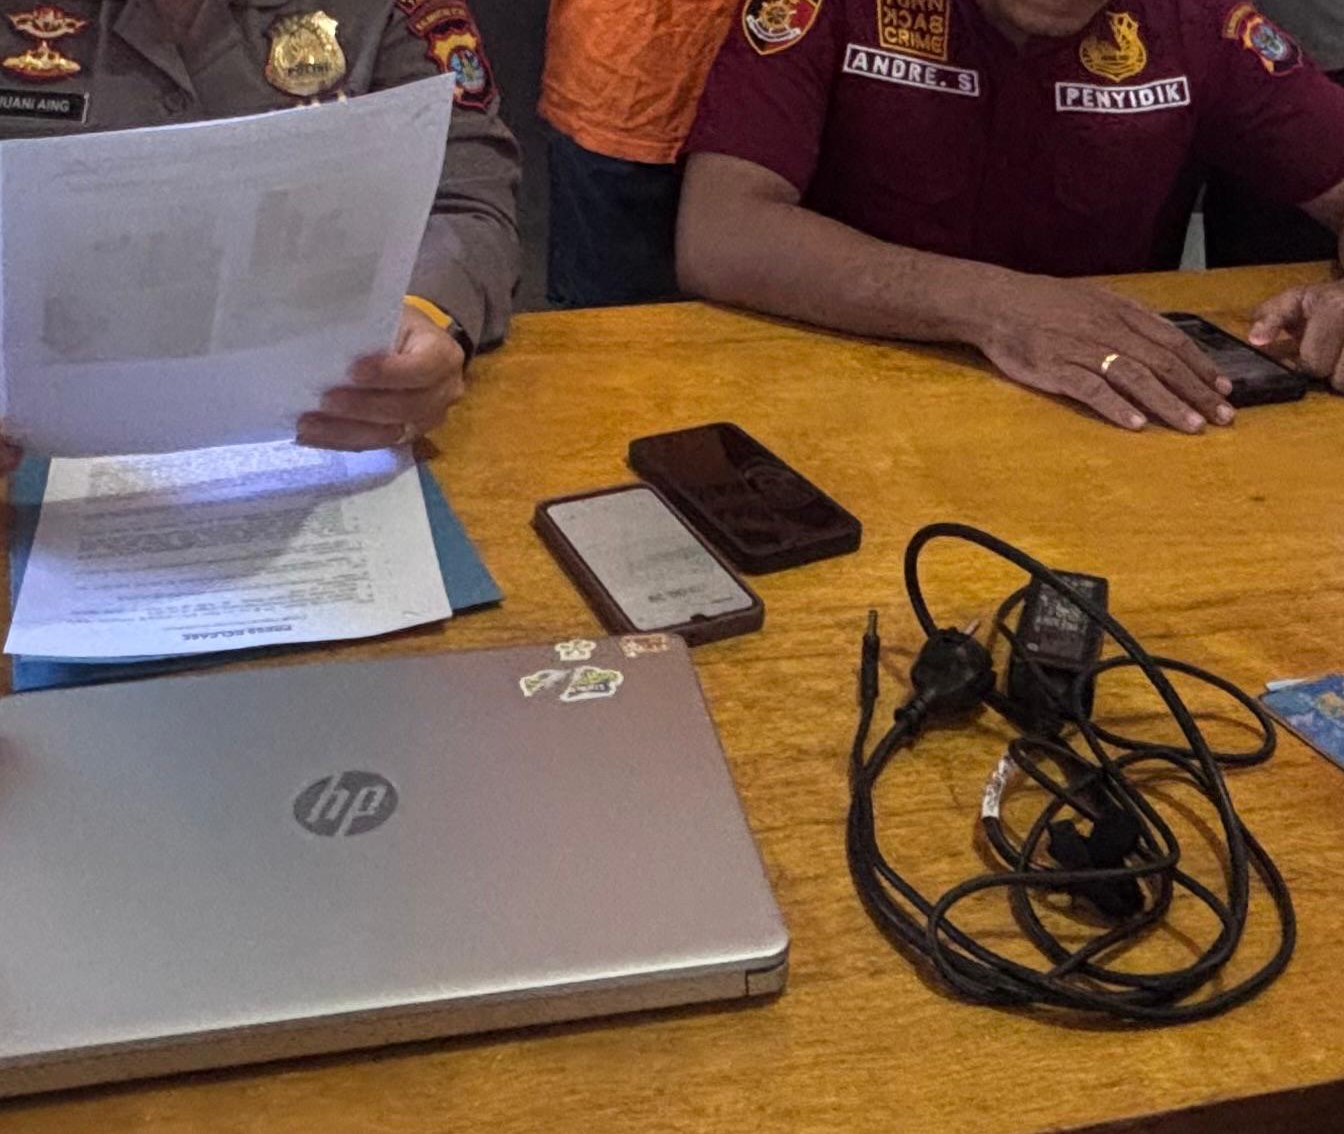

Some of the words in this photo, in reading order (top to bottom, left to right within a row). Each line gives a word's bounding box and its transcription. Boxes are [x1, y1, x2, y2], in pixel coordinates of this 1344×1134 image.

[884, 27, 944, 53] CRIME
[957, 73, 973, 91] S
[1066, 83, 1181, 108] PENYIDIK
[297, 770, 396, 836] hp
